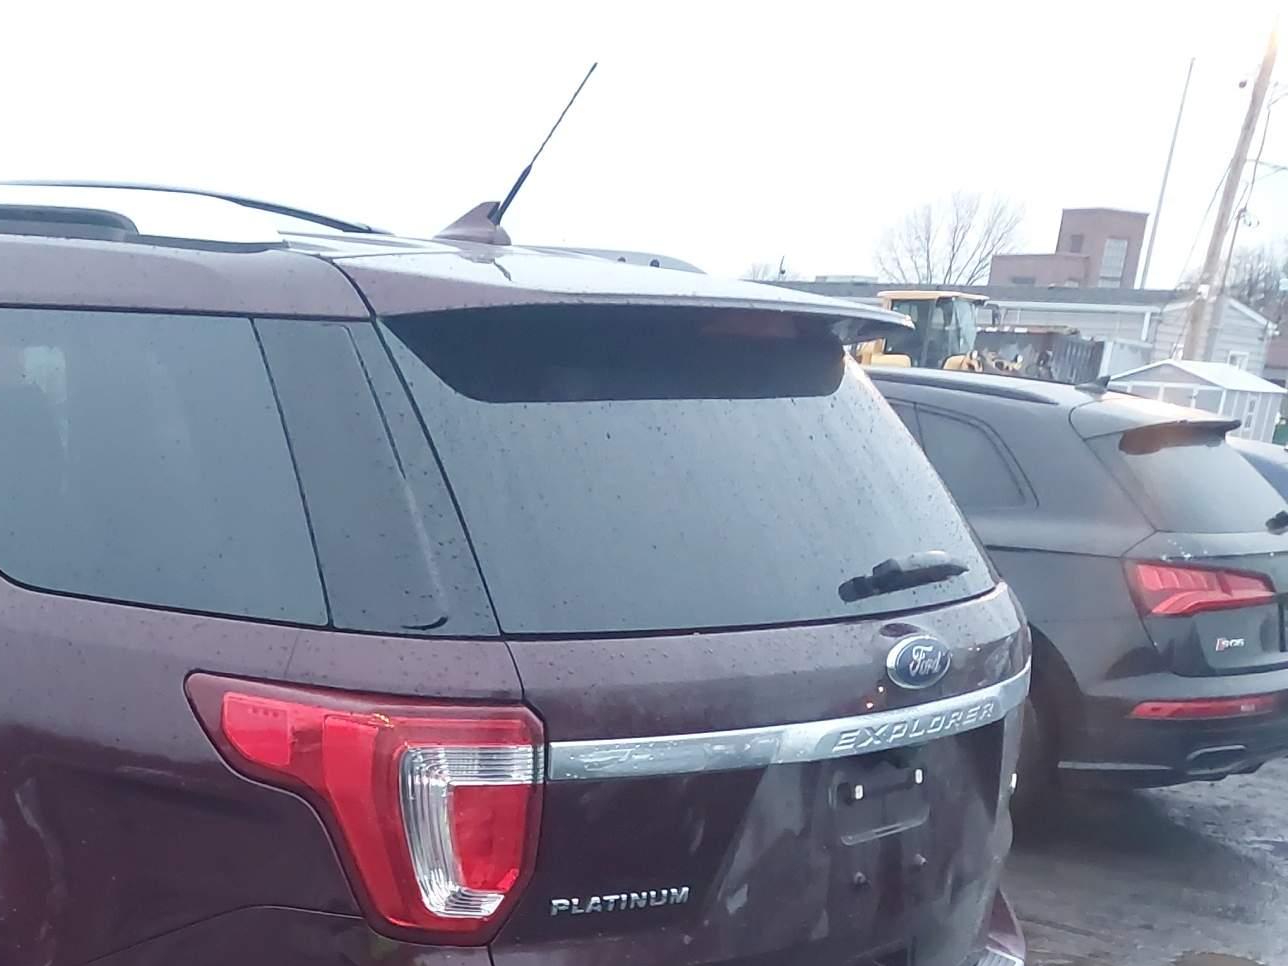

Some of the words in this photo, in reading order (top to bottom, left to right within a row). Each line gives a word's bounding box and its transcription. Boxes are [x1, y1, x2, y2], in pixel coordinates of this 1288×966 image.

[909, 645, 942, 677] Ford
[831, 702, 995, 753] EXPLORER
[550, 886, 690, 917] PLATINUM
